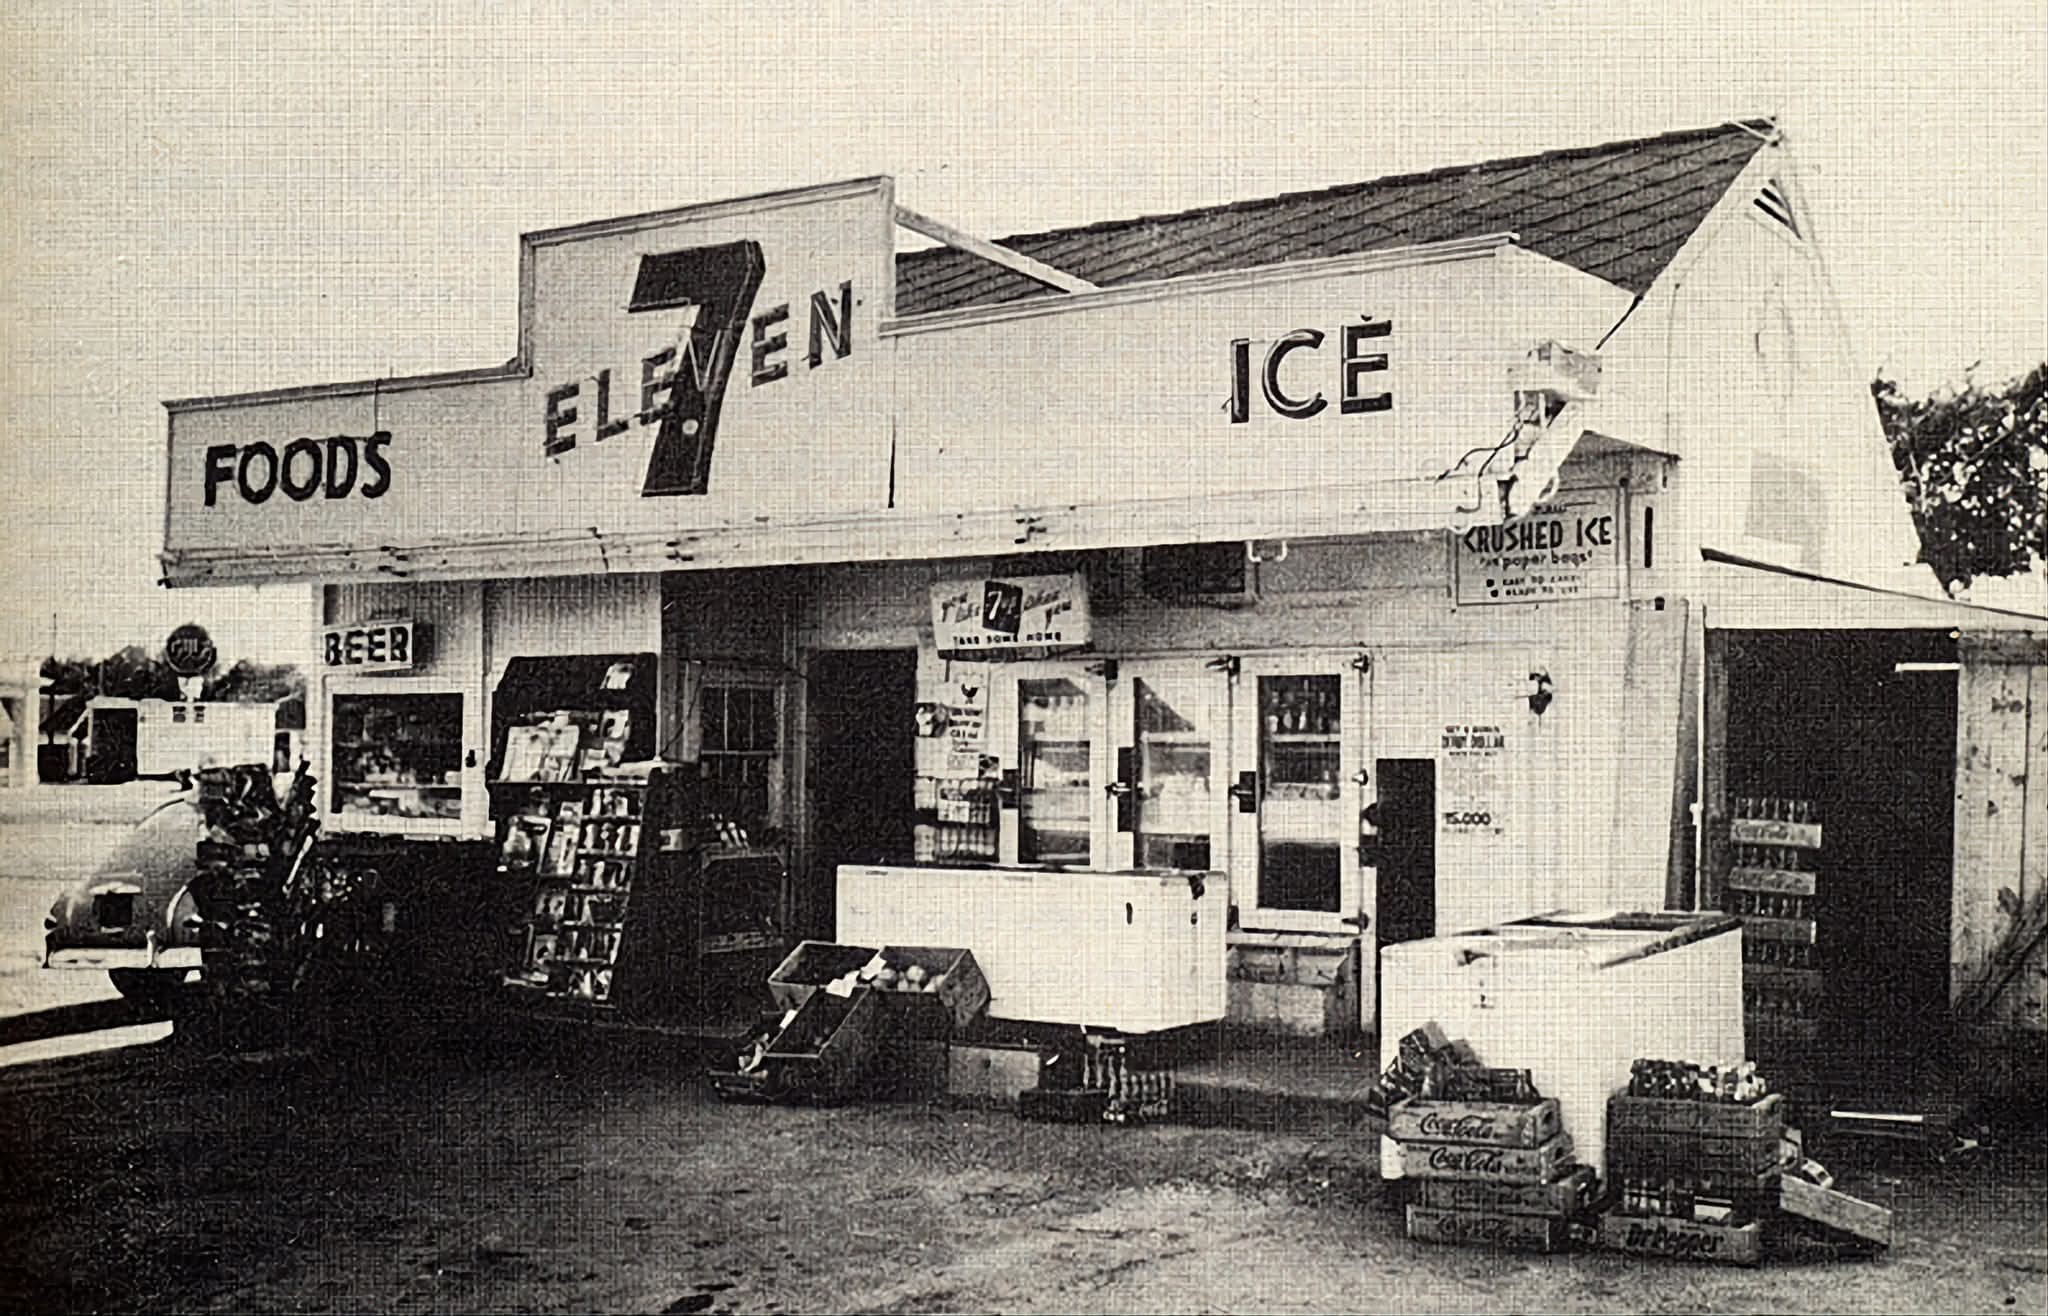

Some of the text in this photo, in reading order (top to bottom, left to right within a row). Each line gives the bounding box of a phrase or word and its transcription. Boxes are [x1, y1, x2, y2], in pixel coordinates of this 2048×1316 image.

[544, 280, 853, 461] ELEVEN
[628, 239, 766, 497] 7
[1230, 319, 1392, 423] ICE
[204, 431, 392, 507] FOODS
[1463, 515, 1613, 553] CRUSHED ICE
[325, 626, 409, 666] BEER
